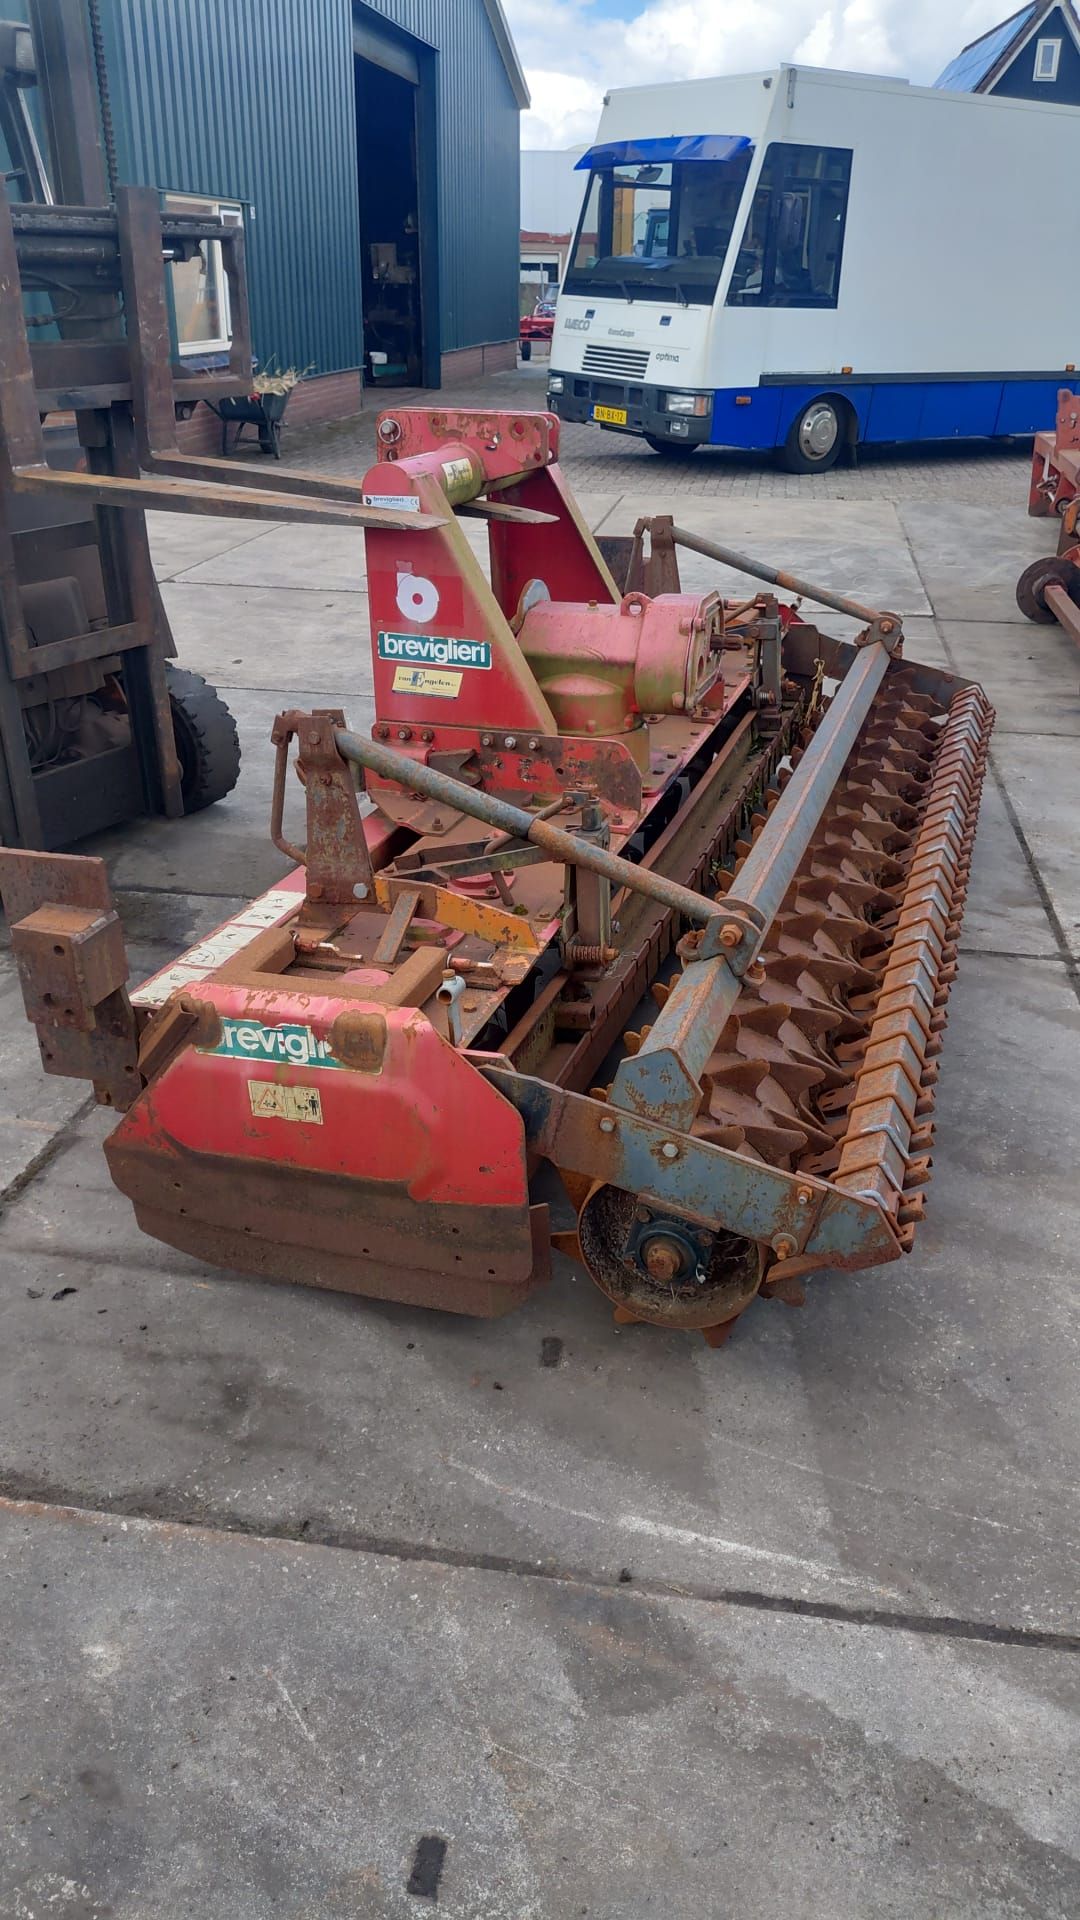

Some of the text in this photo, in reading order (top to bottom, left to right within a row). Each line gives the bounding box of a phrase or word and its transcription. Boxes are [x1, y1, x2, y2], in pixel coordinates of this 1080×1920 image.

[564, 318, 590, 331] IVECO
[655, 353, 679, 362] optima
[383, 633, 486, 664] breviglieri
